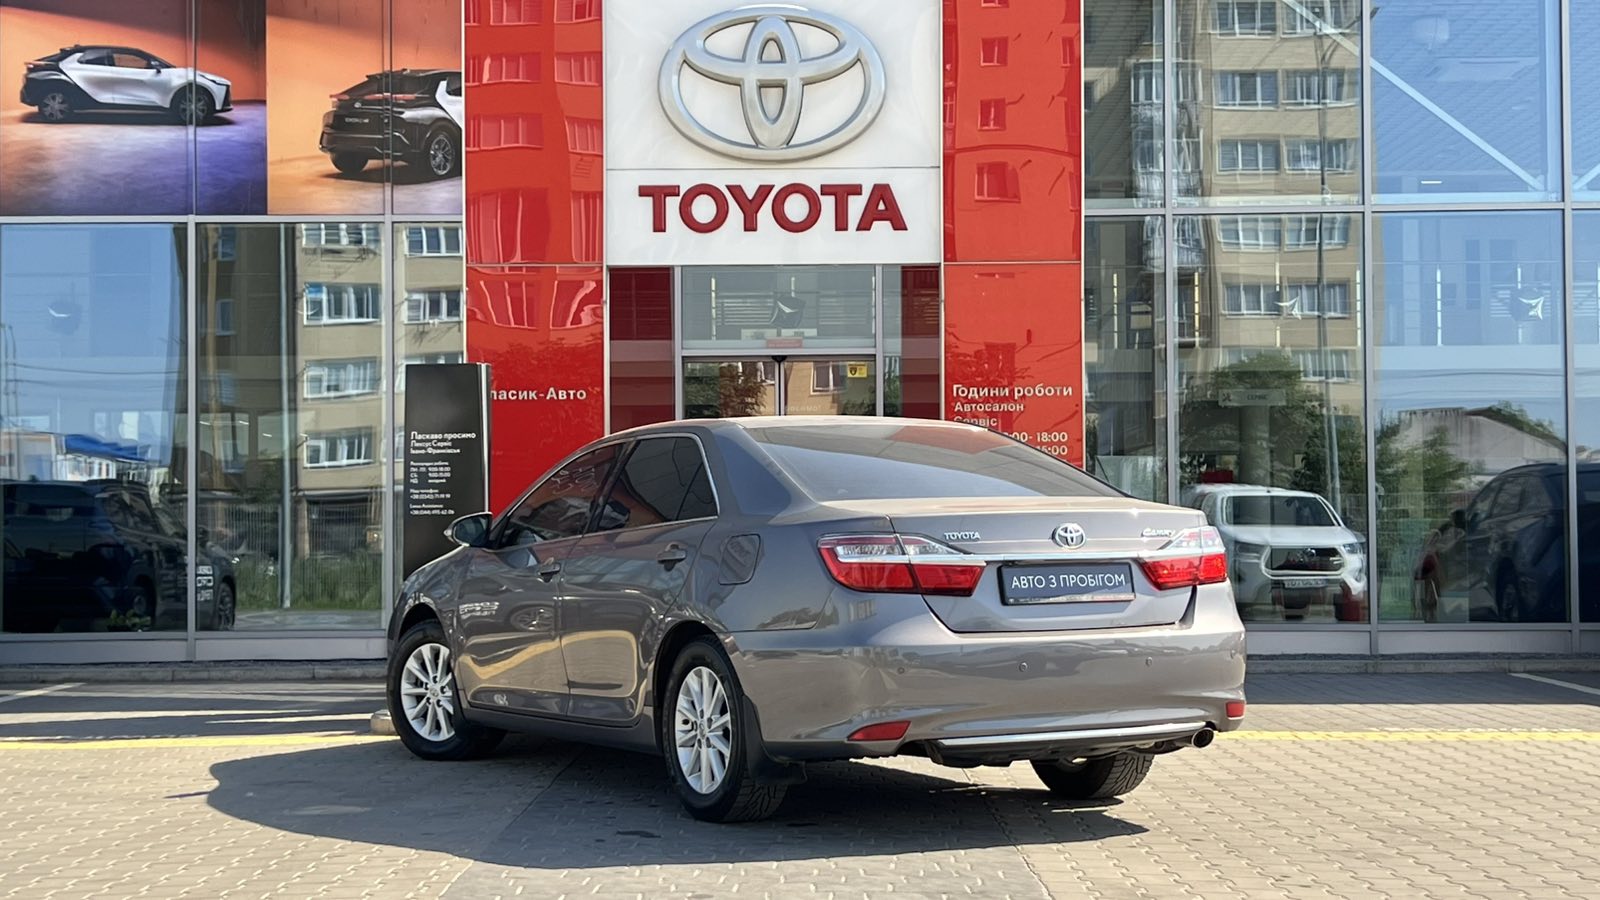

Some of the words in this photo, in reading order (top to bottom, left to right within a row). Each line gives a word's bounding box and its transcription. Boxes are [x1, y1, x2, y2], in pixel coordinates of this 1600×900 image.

[638, 183, 908, 233] TOYOTA
[953, 384, 1009, 399] Години
[1014, 383, 1073, 400] роботи
[954, 402, 1024, 412] Автосалон
[443, 432, 477, 440] просимо
[1036, 431, 1068, 442] 18:00
[943, 531, 981, 540] TOYOTA
[1011, 575, 1046, 589] АВТО
[1049, 574, 1057, 587] З
[1060, 573, 1126, 587] ПРОБІГОМ
